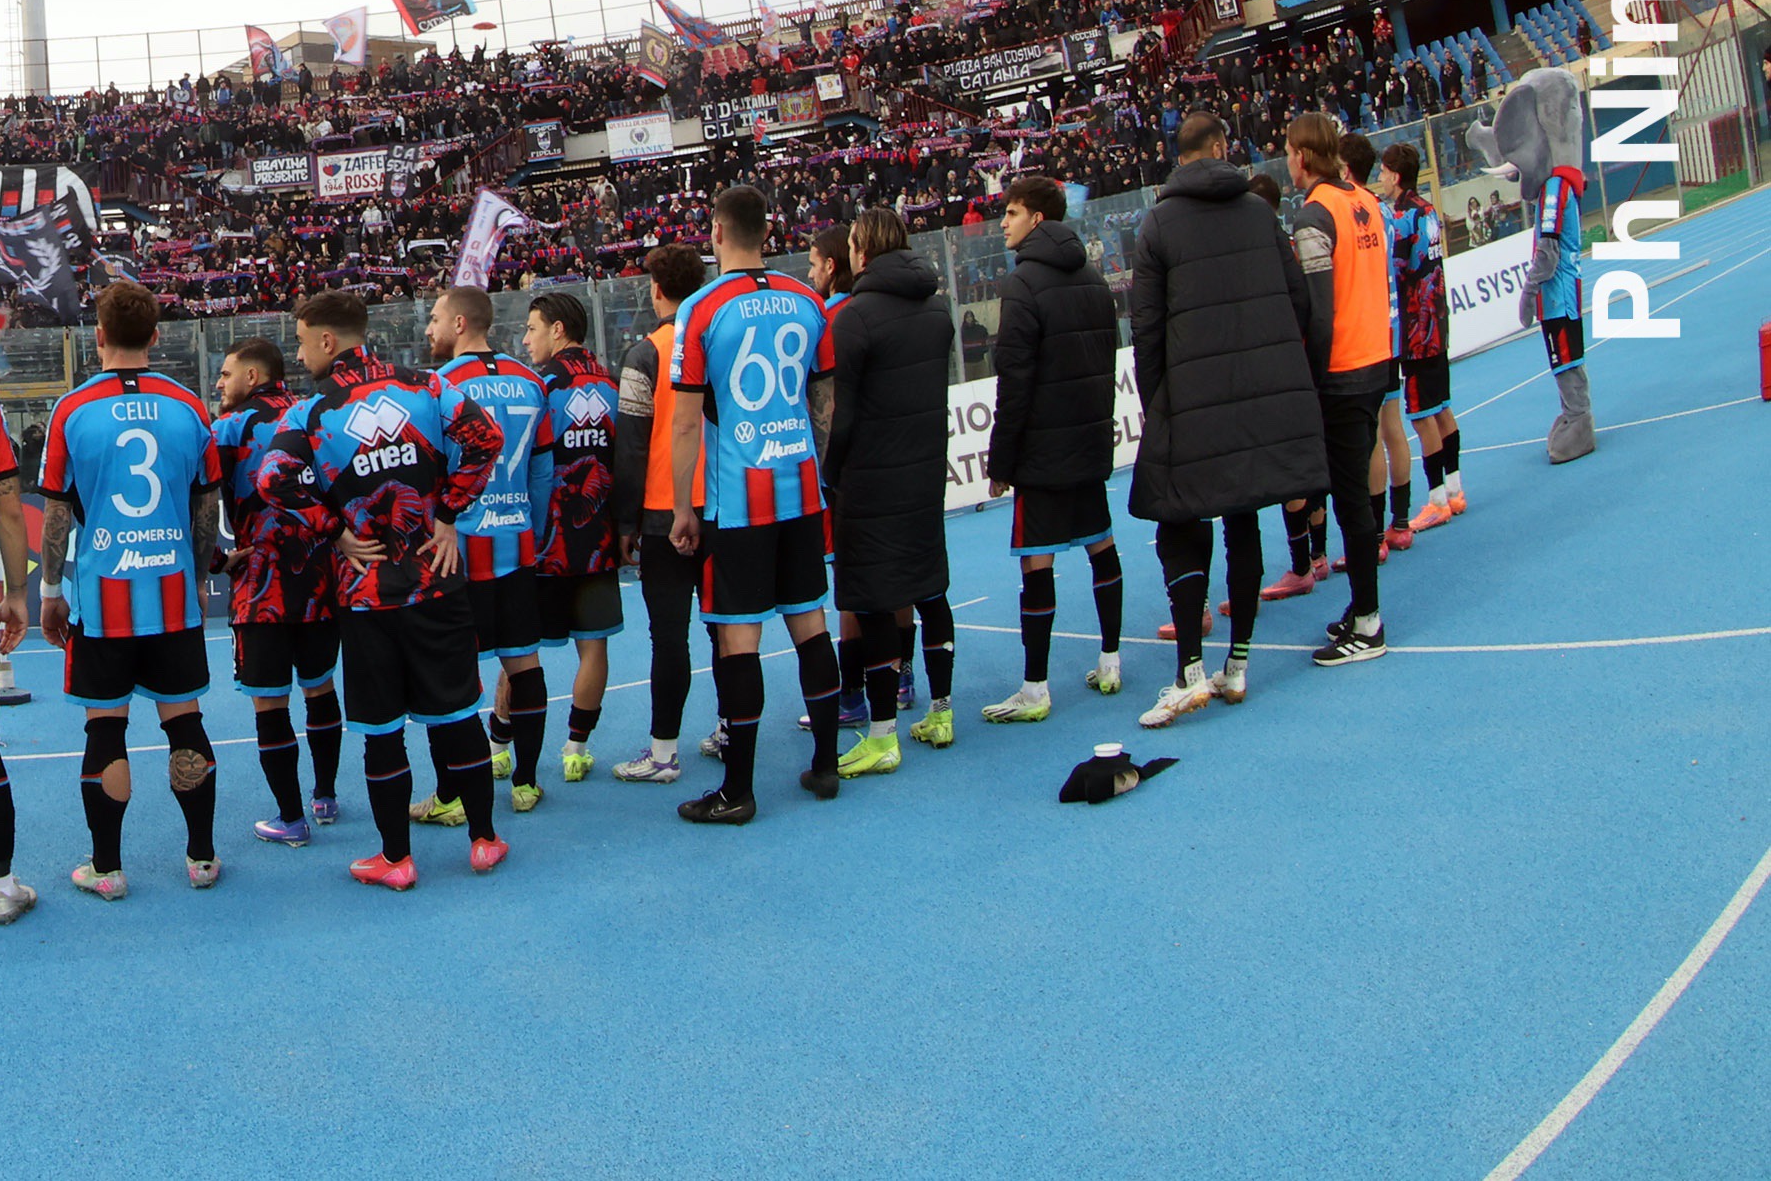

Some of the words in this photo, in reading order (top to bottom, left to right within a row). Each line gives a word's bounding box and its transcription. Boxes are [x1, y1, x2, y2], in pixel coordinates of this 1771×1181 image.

[944, 59, 981, 76] PIAZZA
[983, 52, 1003, 69] SAN
[960, 63, 1031, 90] CATANIA
[253, 156, 308, 172] GRAVINA
[254, 170, 309, 185] PRESENTE
[1477, 259, 1536, 304] SYSTE
[739, 297, 799, 320] IERARDI
[729, 321, 809, 412] 68
[469, 383, 484, 400] DI
[486, 382, 526, 400] NOIA
[111, 401, 159, 422] CELLI
[110, 428, 162, 518] 3
[116, 530, 166, 544] COMER
[111, 548, 176, 576] Muracel
